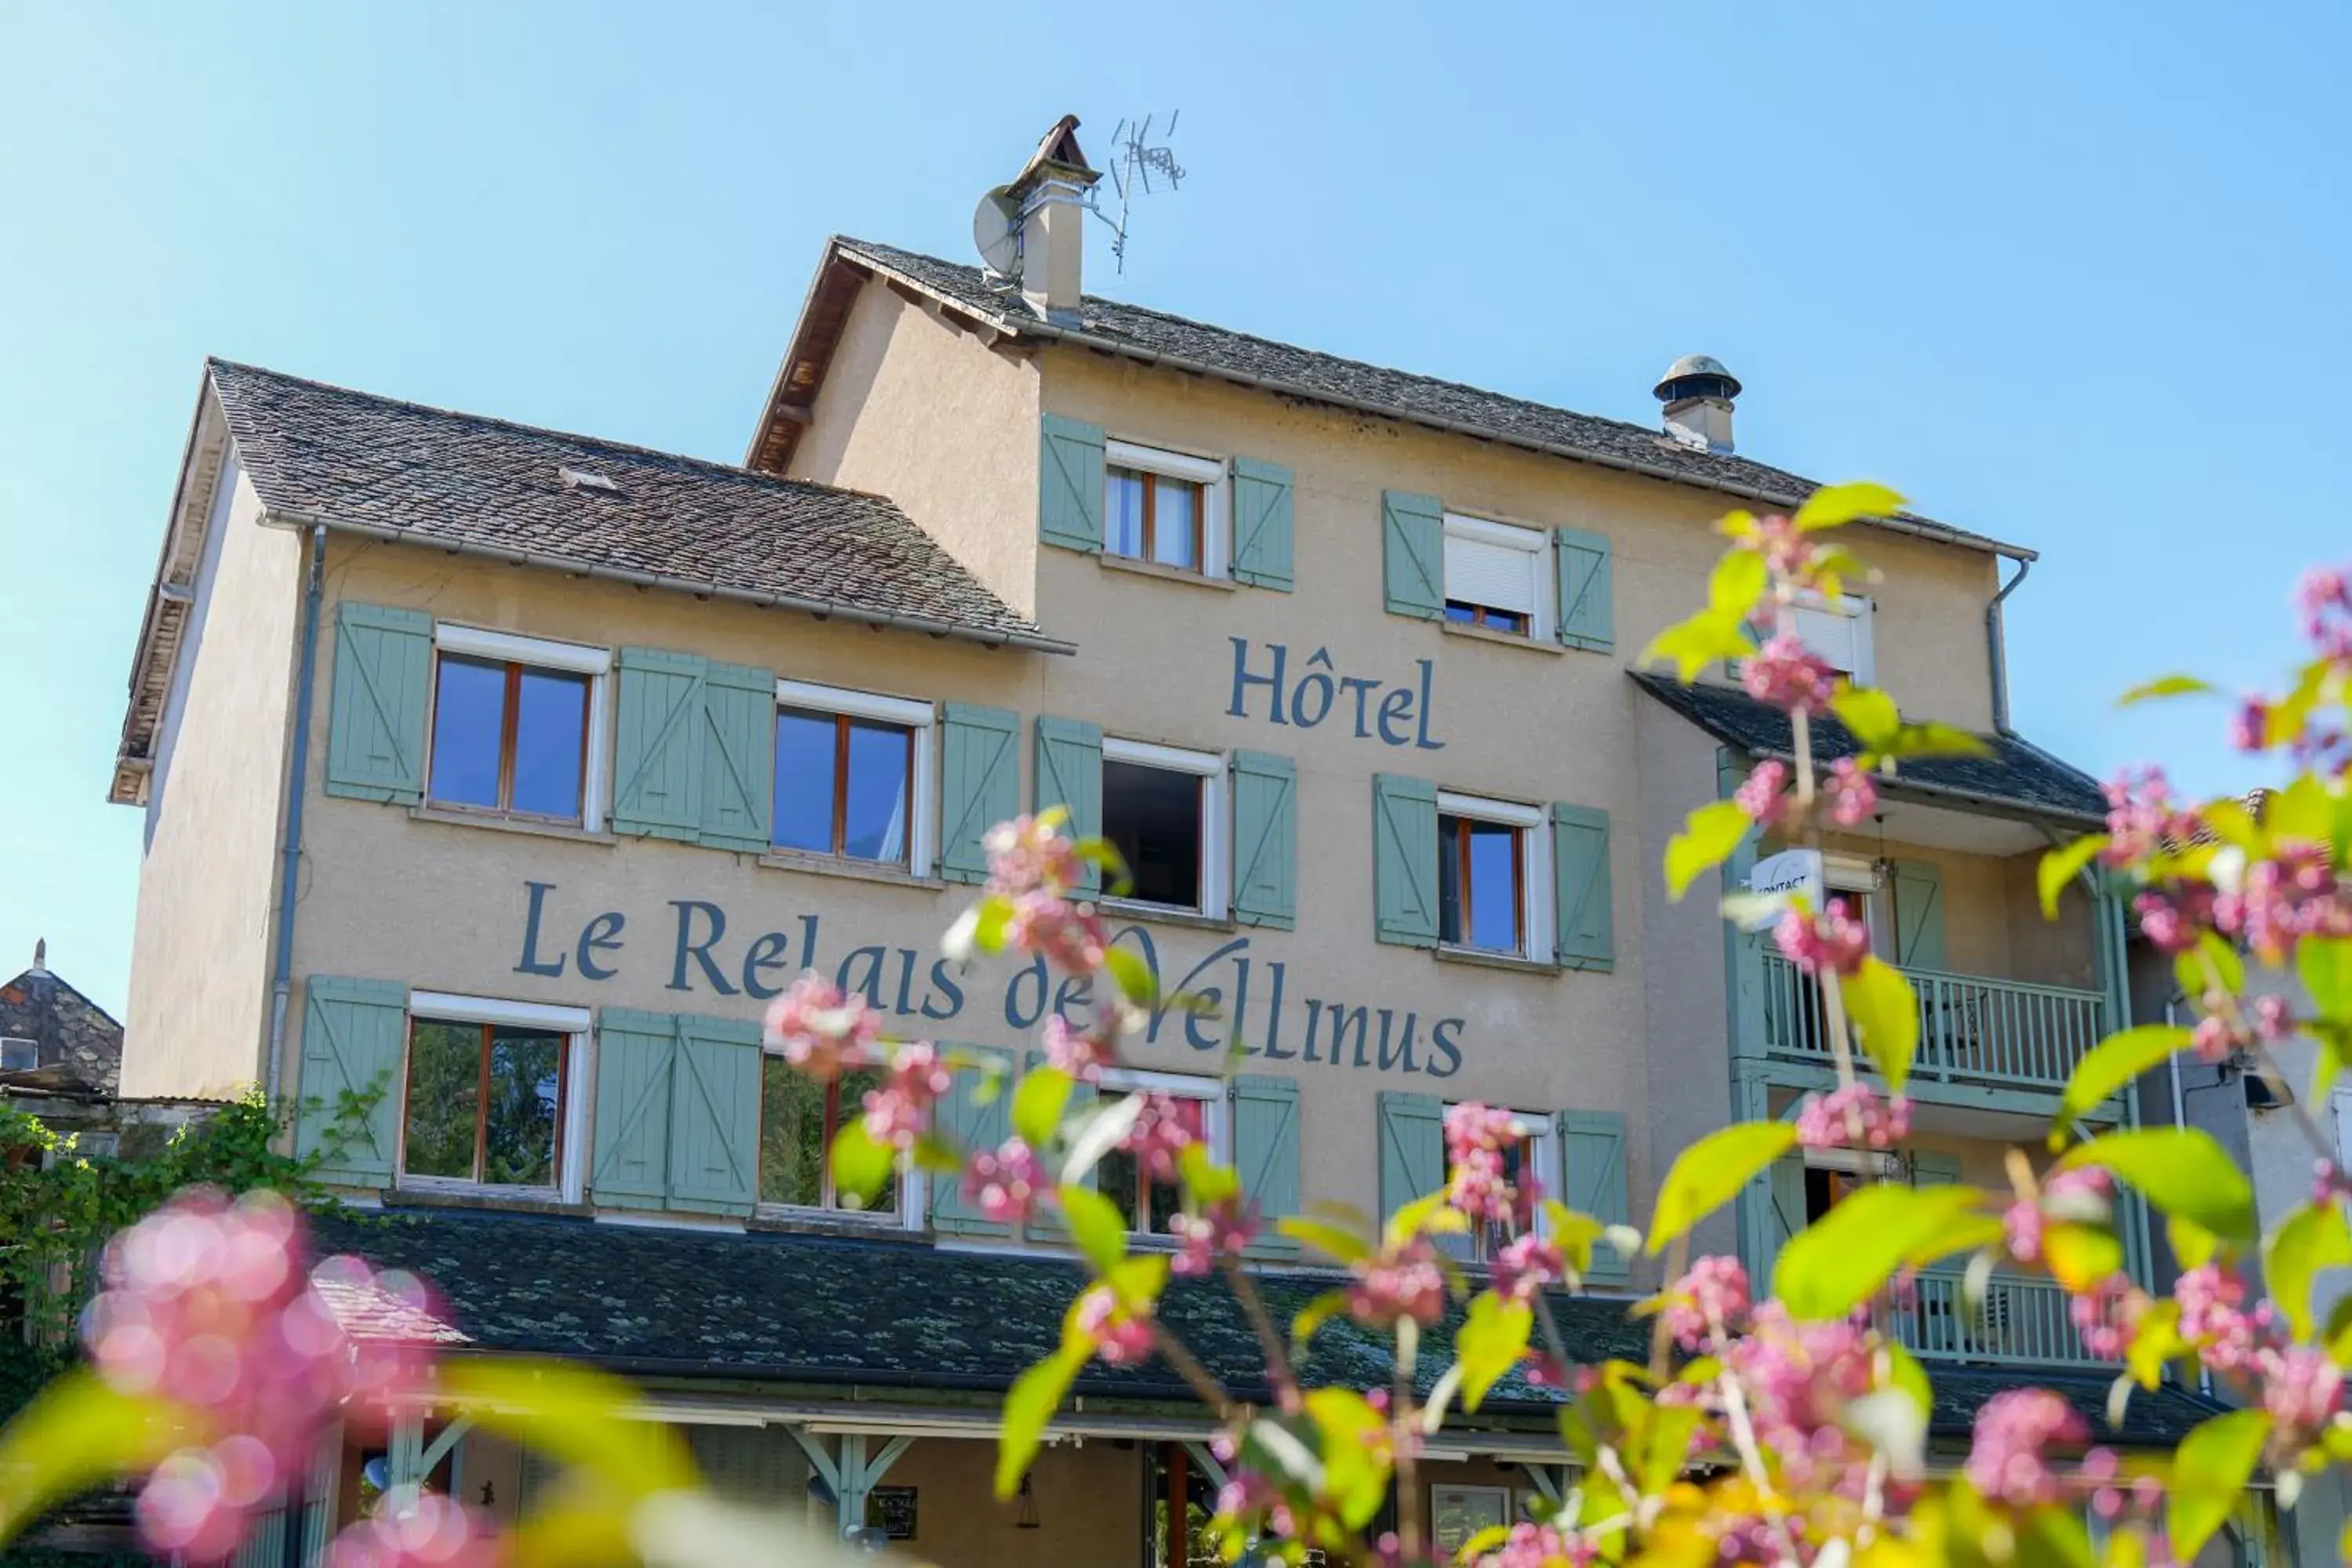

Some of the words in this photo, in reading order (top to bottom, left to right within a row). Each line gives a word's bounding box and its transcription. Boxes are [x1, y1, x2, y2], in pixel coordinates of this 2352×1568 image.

[1225, 636, 1446, 750] Hôtel
[512, 880, 625, 980] Le
[664, 900, 965, 1020] Relais
[1004, 946, 1095, 1034] de
[1108, 925, 1465, 1078] Vellinus
